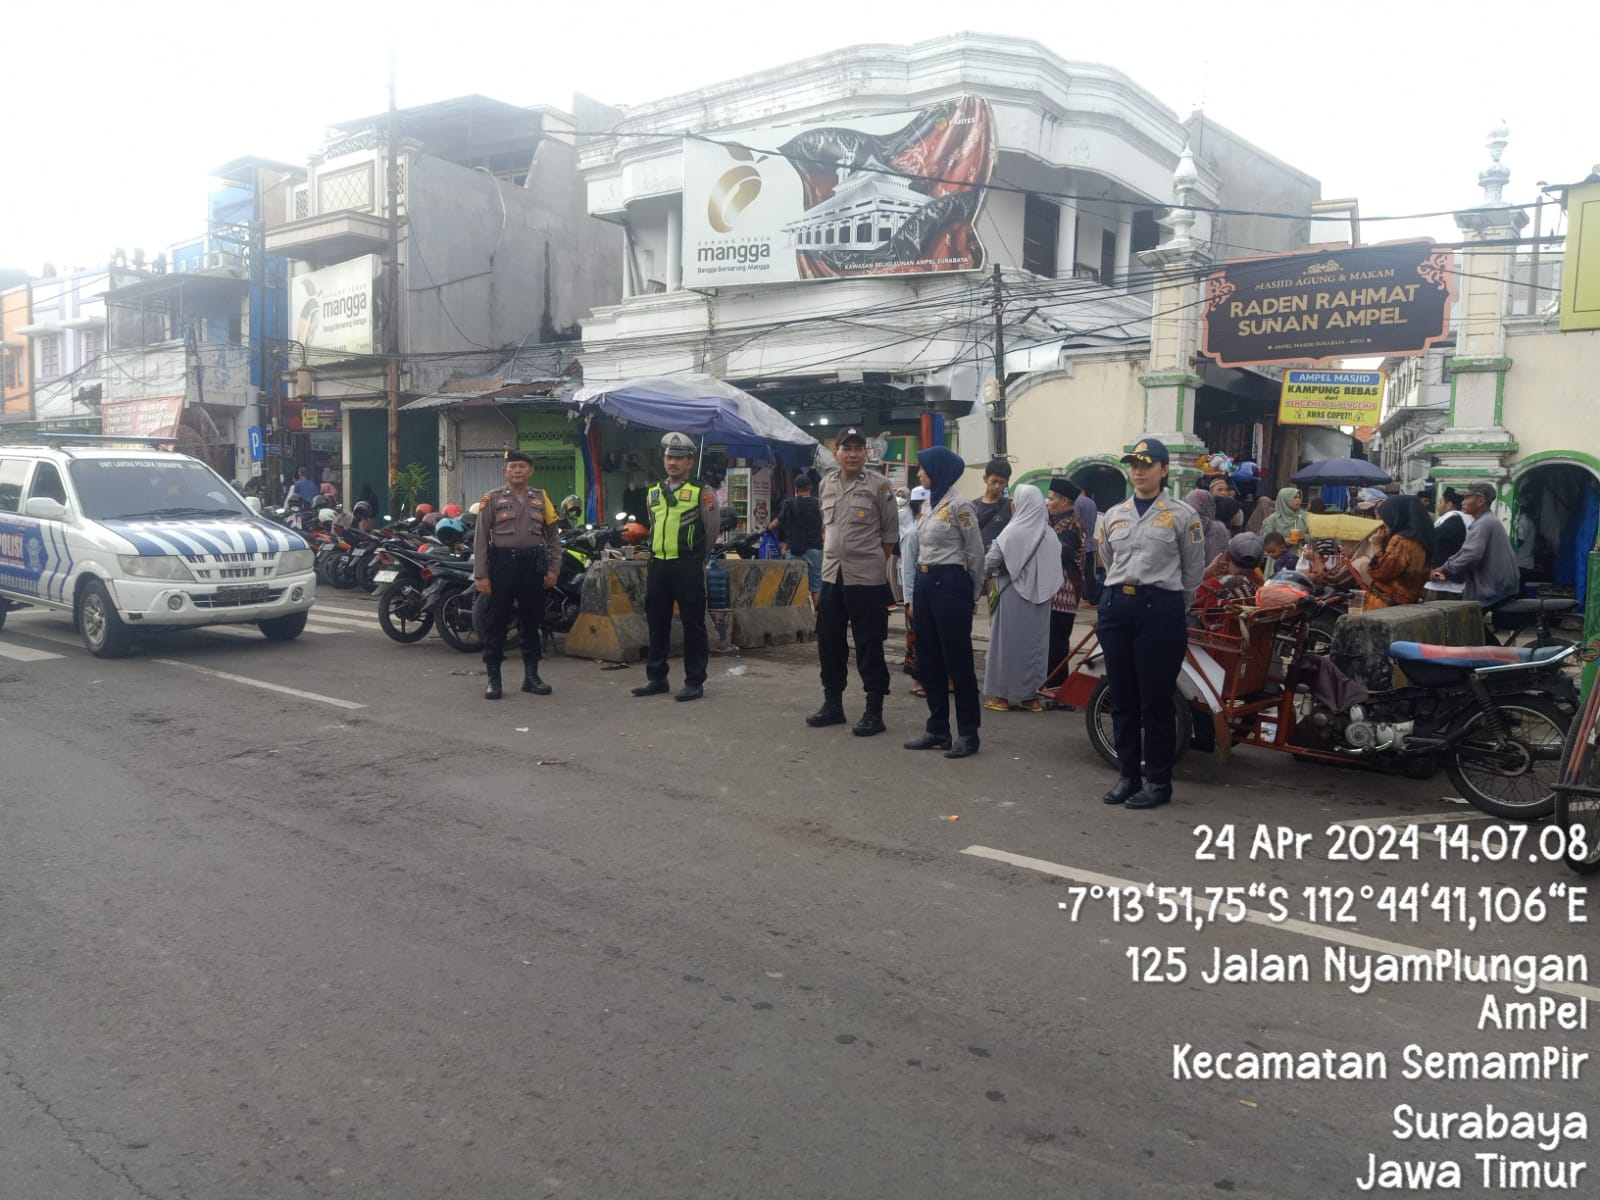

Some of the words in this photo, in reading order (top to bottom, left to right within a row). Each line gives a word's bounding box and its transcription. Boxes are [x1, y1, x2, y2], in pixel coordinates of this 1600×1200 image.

[697, 243, 770, 264] mangga
[1255, 279, 1293, 291] MASJID
[1296, 275, 1335, 286] AGUNG
[1338, 273, 1346, 281] &
[1349, 268, 1395, 281] MAKAM
[323, 292, 367, 318] mangga
[1230, 294, 1308, 318] RADEN
[1315, 284, 1420, 309] RAHMAT
[1238, 313, 1319, 336] SUNAN
[1326, 306, 1408, 329] AMPEL
[1299, 373, 1332, 382] AMPEL
[1333, 374, 1370, 383] MASJID
[1287, 385, 1340, 395] KAMPUNG
[1343, 386, 1378, 396] BEBAS
[1307, 410, 1326, 418] AWAS
[251, 432, 260, 456] P
[0, 533, 24, 558] OLISI
